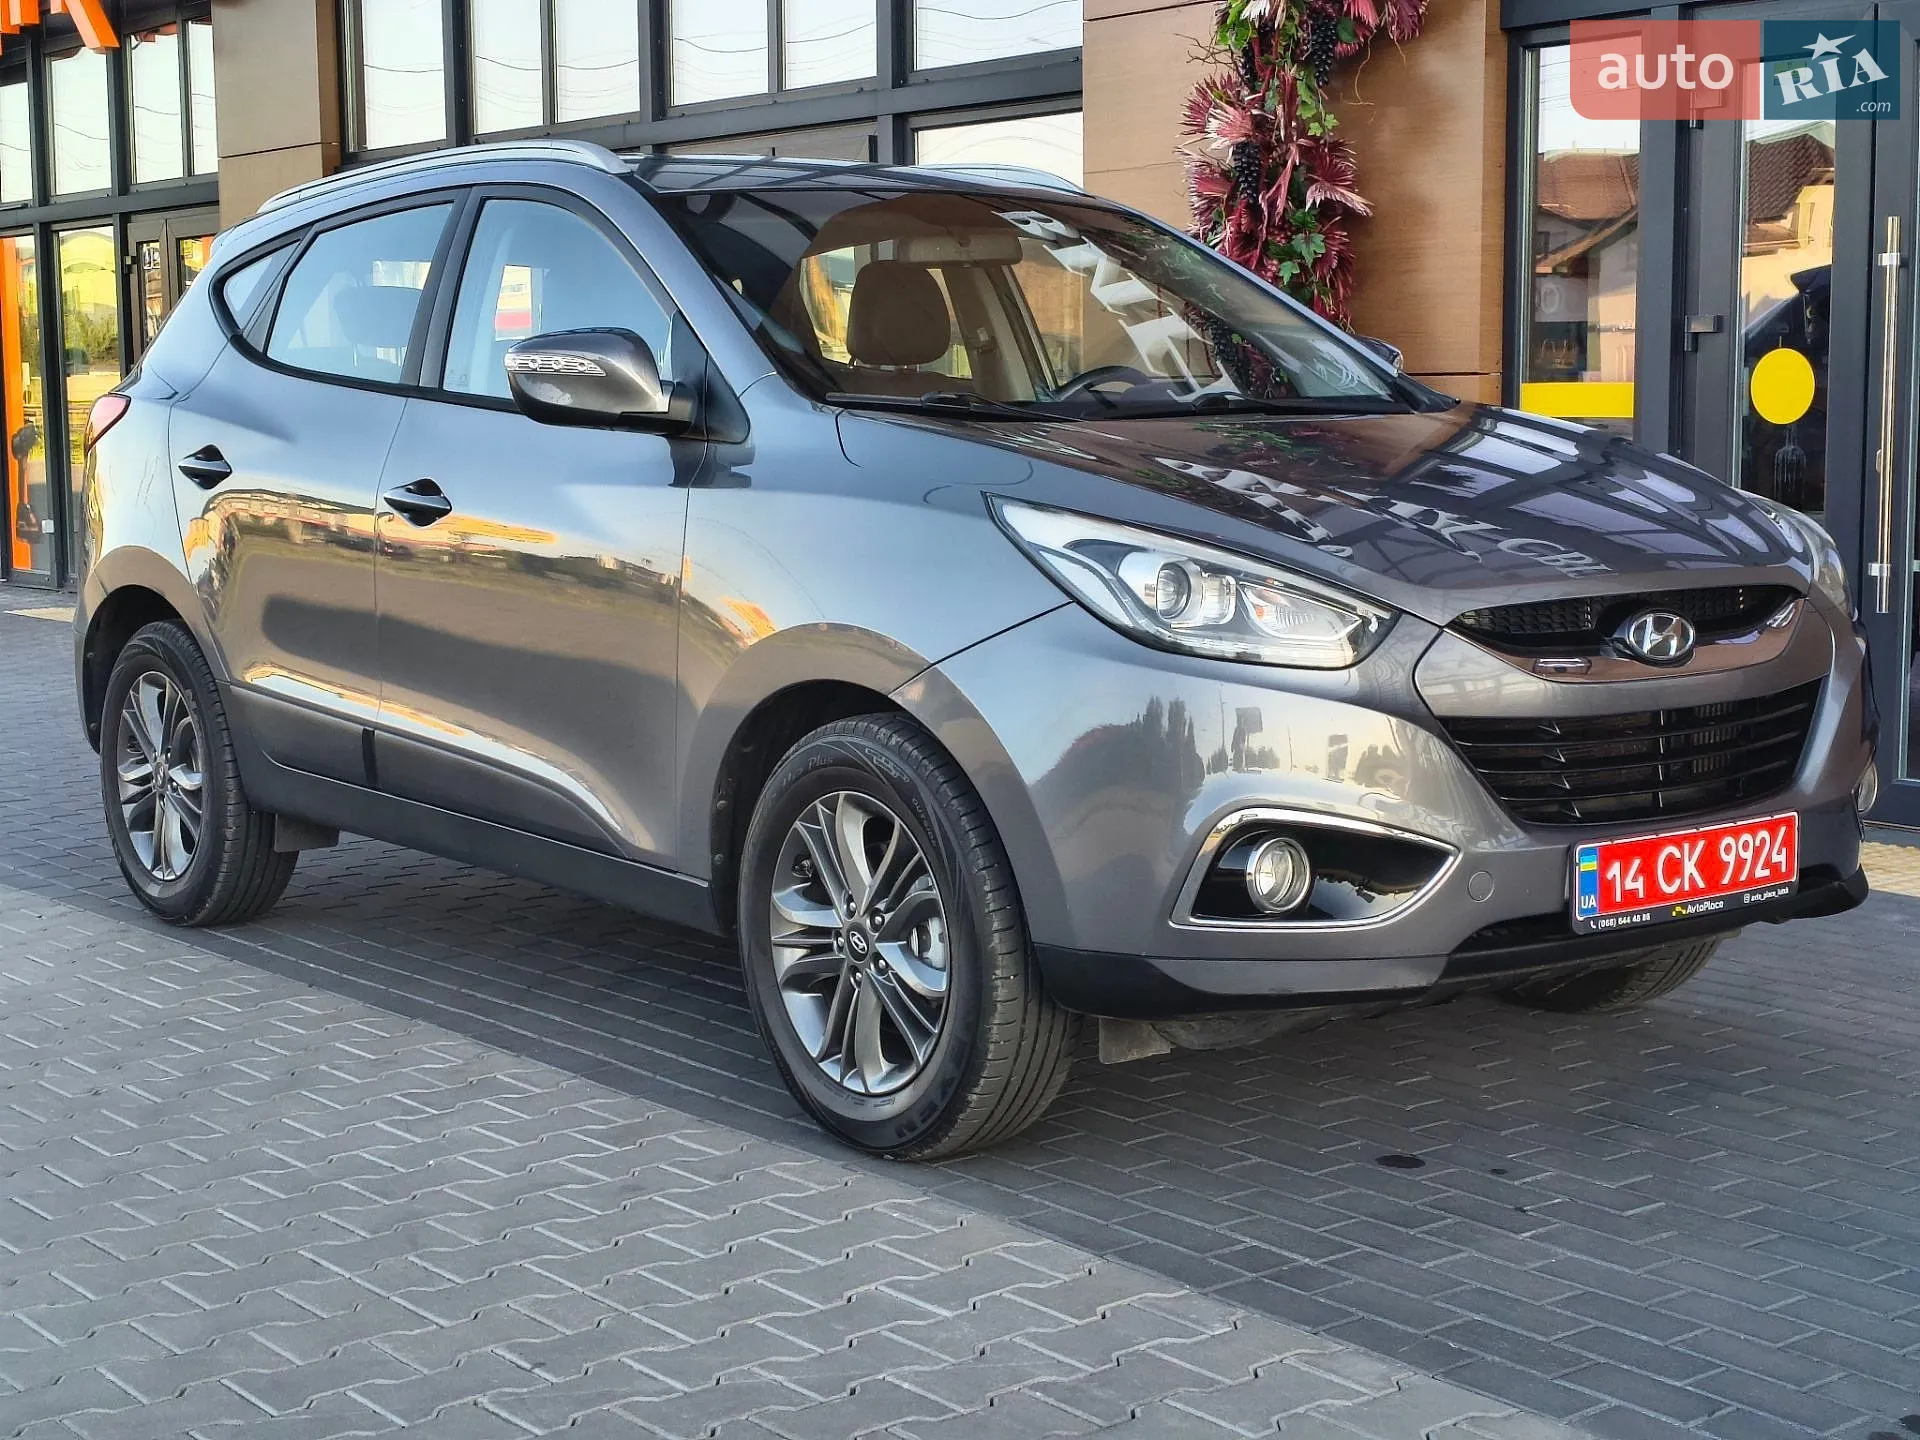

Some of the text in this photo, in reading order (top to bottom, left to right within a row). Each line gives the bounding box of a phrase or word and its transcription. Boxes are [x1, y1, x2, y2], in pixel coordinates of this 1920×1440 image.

[1606, 825, 1787, 903] 14 CK 9924
[1581, 894, 1597, 909] UA
